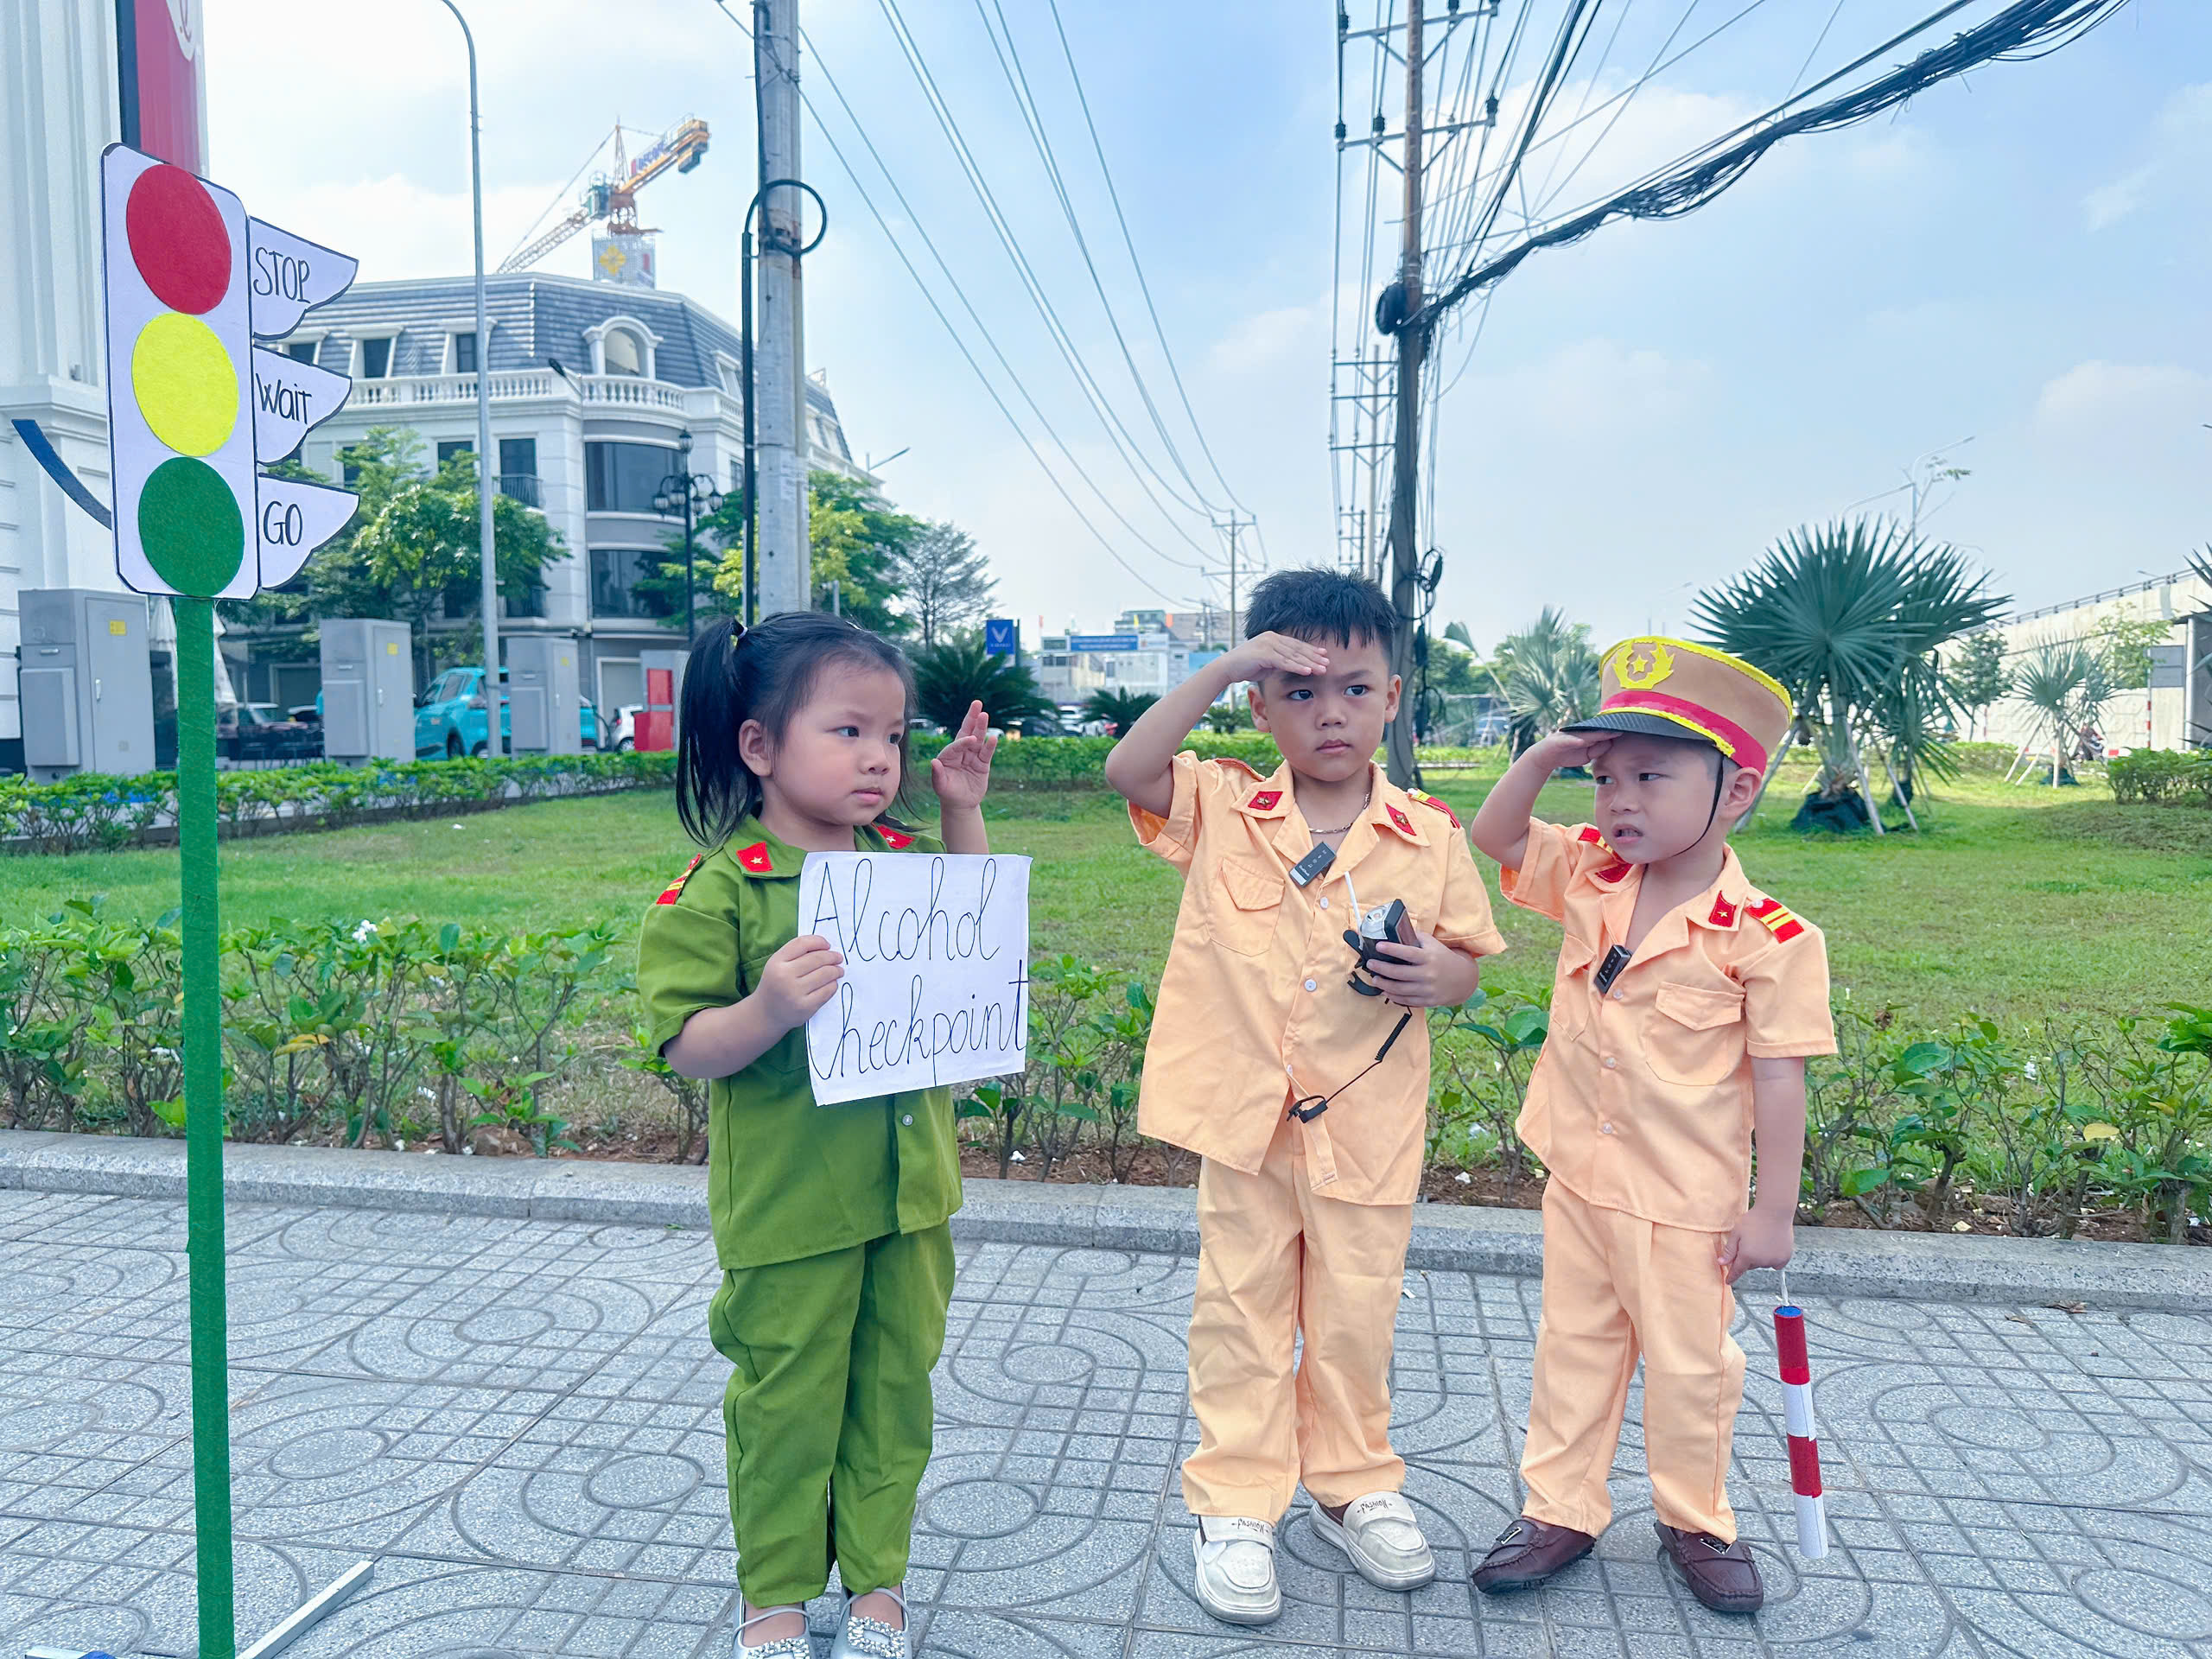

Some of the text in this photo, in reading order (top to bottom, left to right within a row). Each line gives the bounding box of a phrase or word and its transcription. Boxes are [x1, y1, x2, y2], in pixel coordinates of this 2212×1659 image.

[253, 246, 311, 304] STOP
[263, 500, 303, 546] GO
[811, 856, 1001, 965] Alcohol
